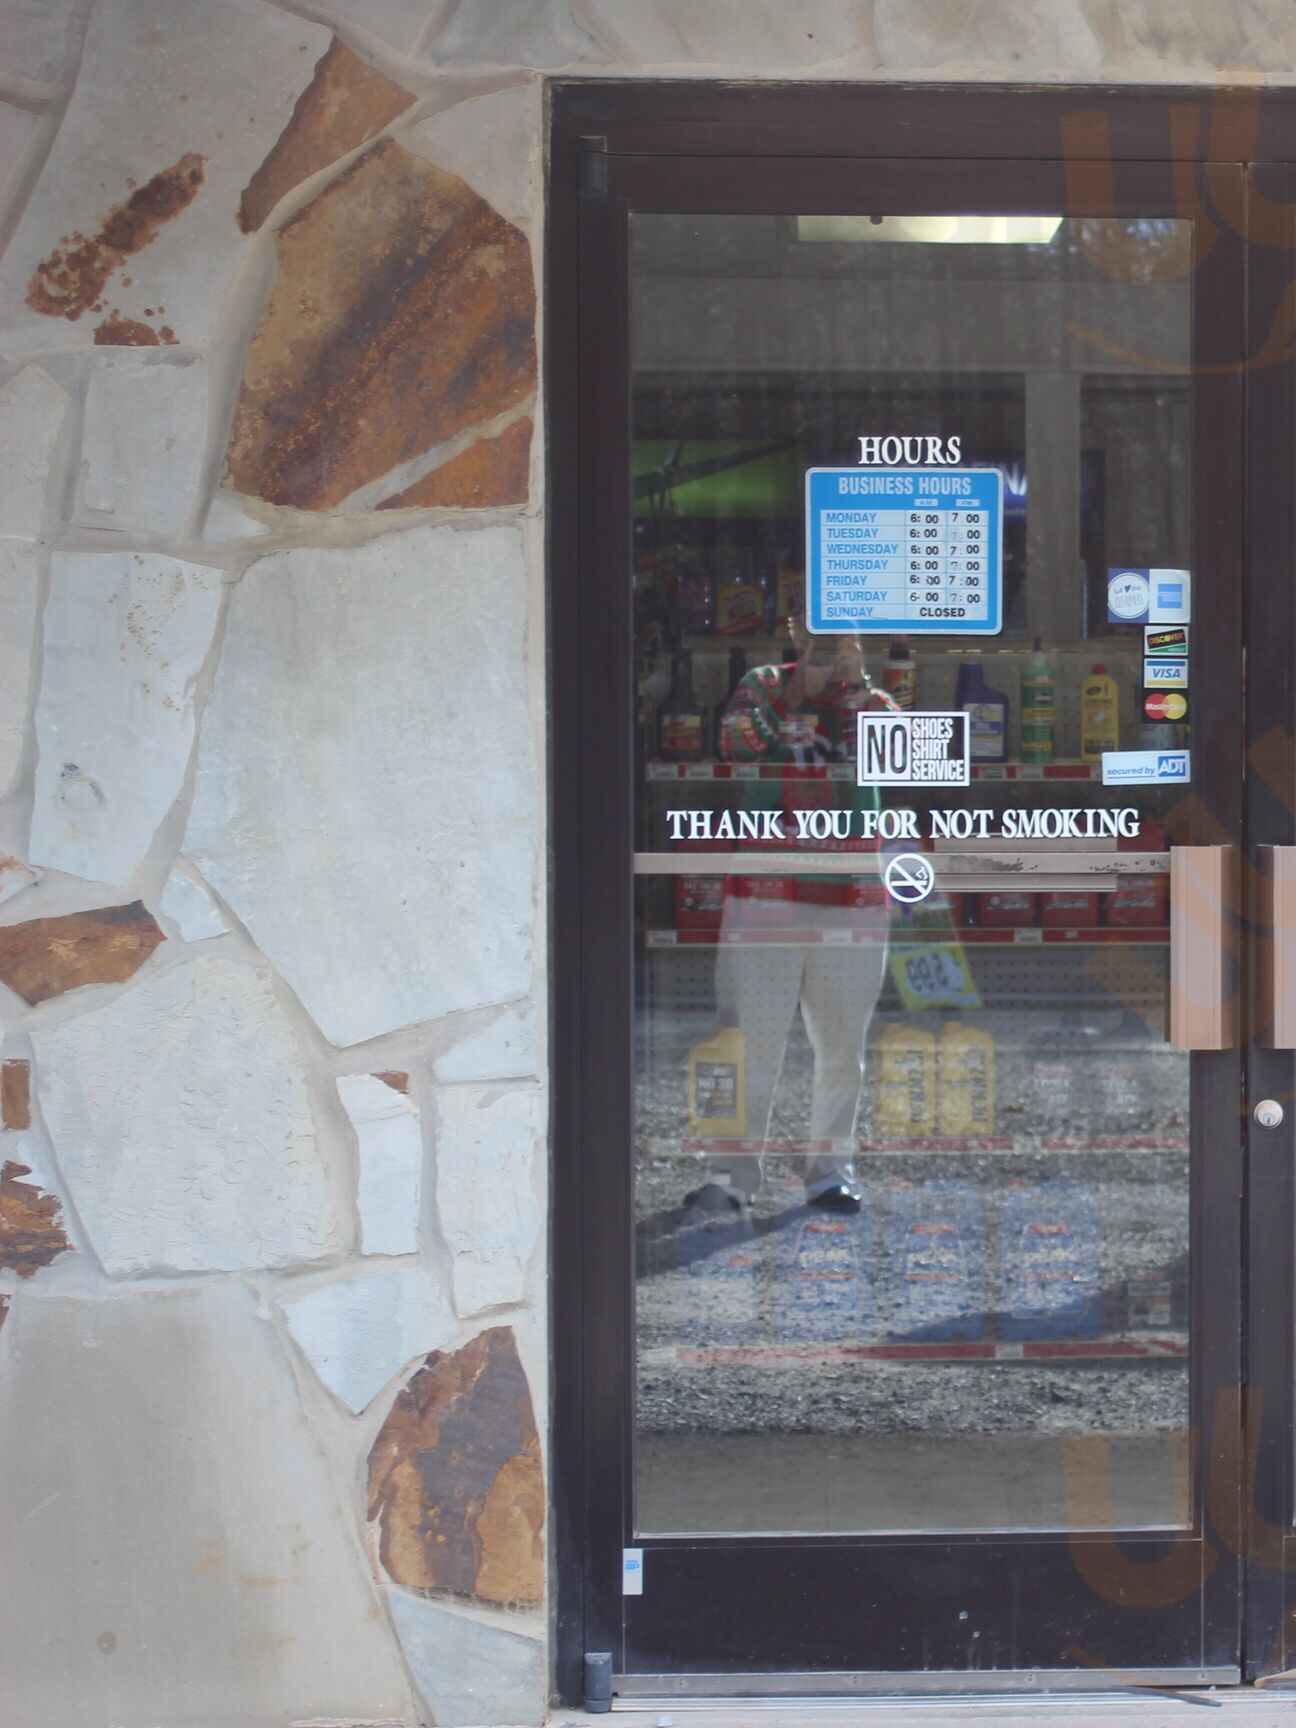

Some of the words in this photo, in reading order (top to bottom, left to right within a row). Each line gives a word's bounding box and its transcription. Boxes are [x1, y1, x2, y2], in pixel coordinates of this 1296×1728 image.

[858, 436, 961, 465] HOURS
[838, 476, 914, 495] BUSINESS
[918, 477, 972, 495] HOURS
[826, 512, 877, 523] MONDAY
[827, 528, 879, 538] TUESDAY
[826, 544, 899, 554] WEDNESDAY
[827, 559, 889, 570] THURSDAY
[826, 575, 868, 586] FRIDAY
[826, 591, 887, 601] SATURDAY
[826, 607, 874, 617] SUNDAY
[919, 607, 966, 618] CLOSED
[1152, 668, 1181, 678] VISA
[912, 718, 954, 739] SHOES
[867, 724, 907, 774] NO
[912, 739, 950, 759] SHIRT
[912, 760, 964, 780] SERVICE
[1106, 766, 1143, 775] secured
[1144, 766, 1156, 777] by
[1158, 758, 1186, 774] ADT
[666, 809, 786, 839] THANK
[793, 809, 853, 839] YOU
[860, 809, 922, 839] FOR
[928, 809, 994, 839] NOT
[1001, 808, 1141, 838] SMOKING
